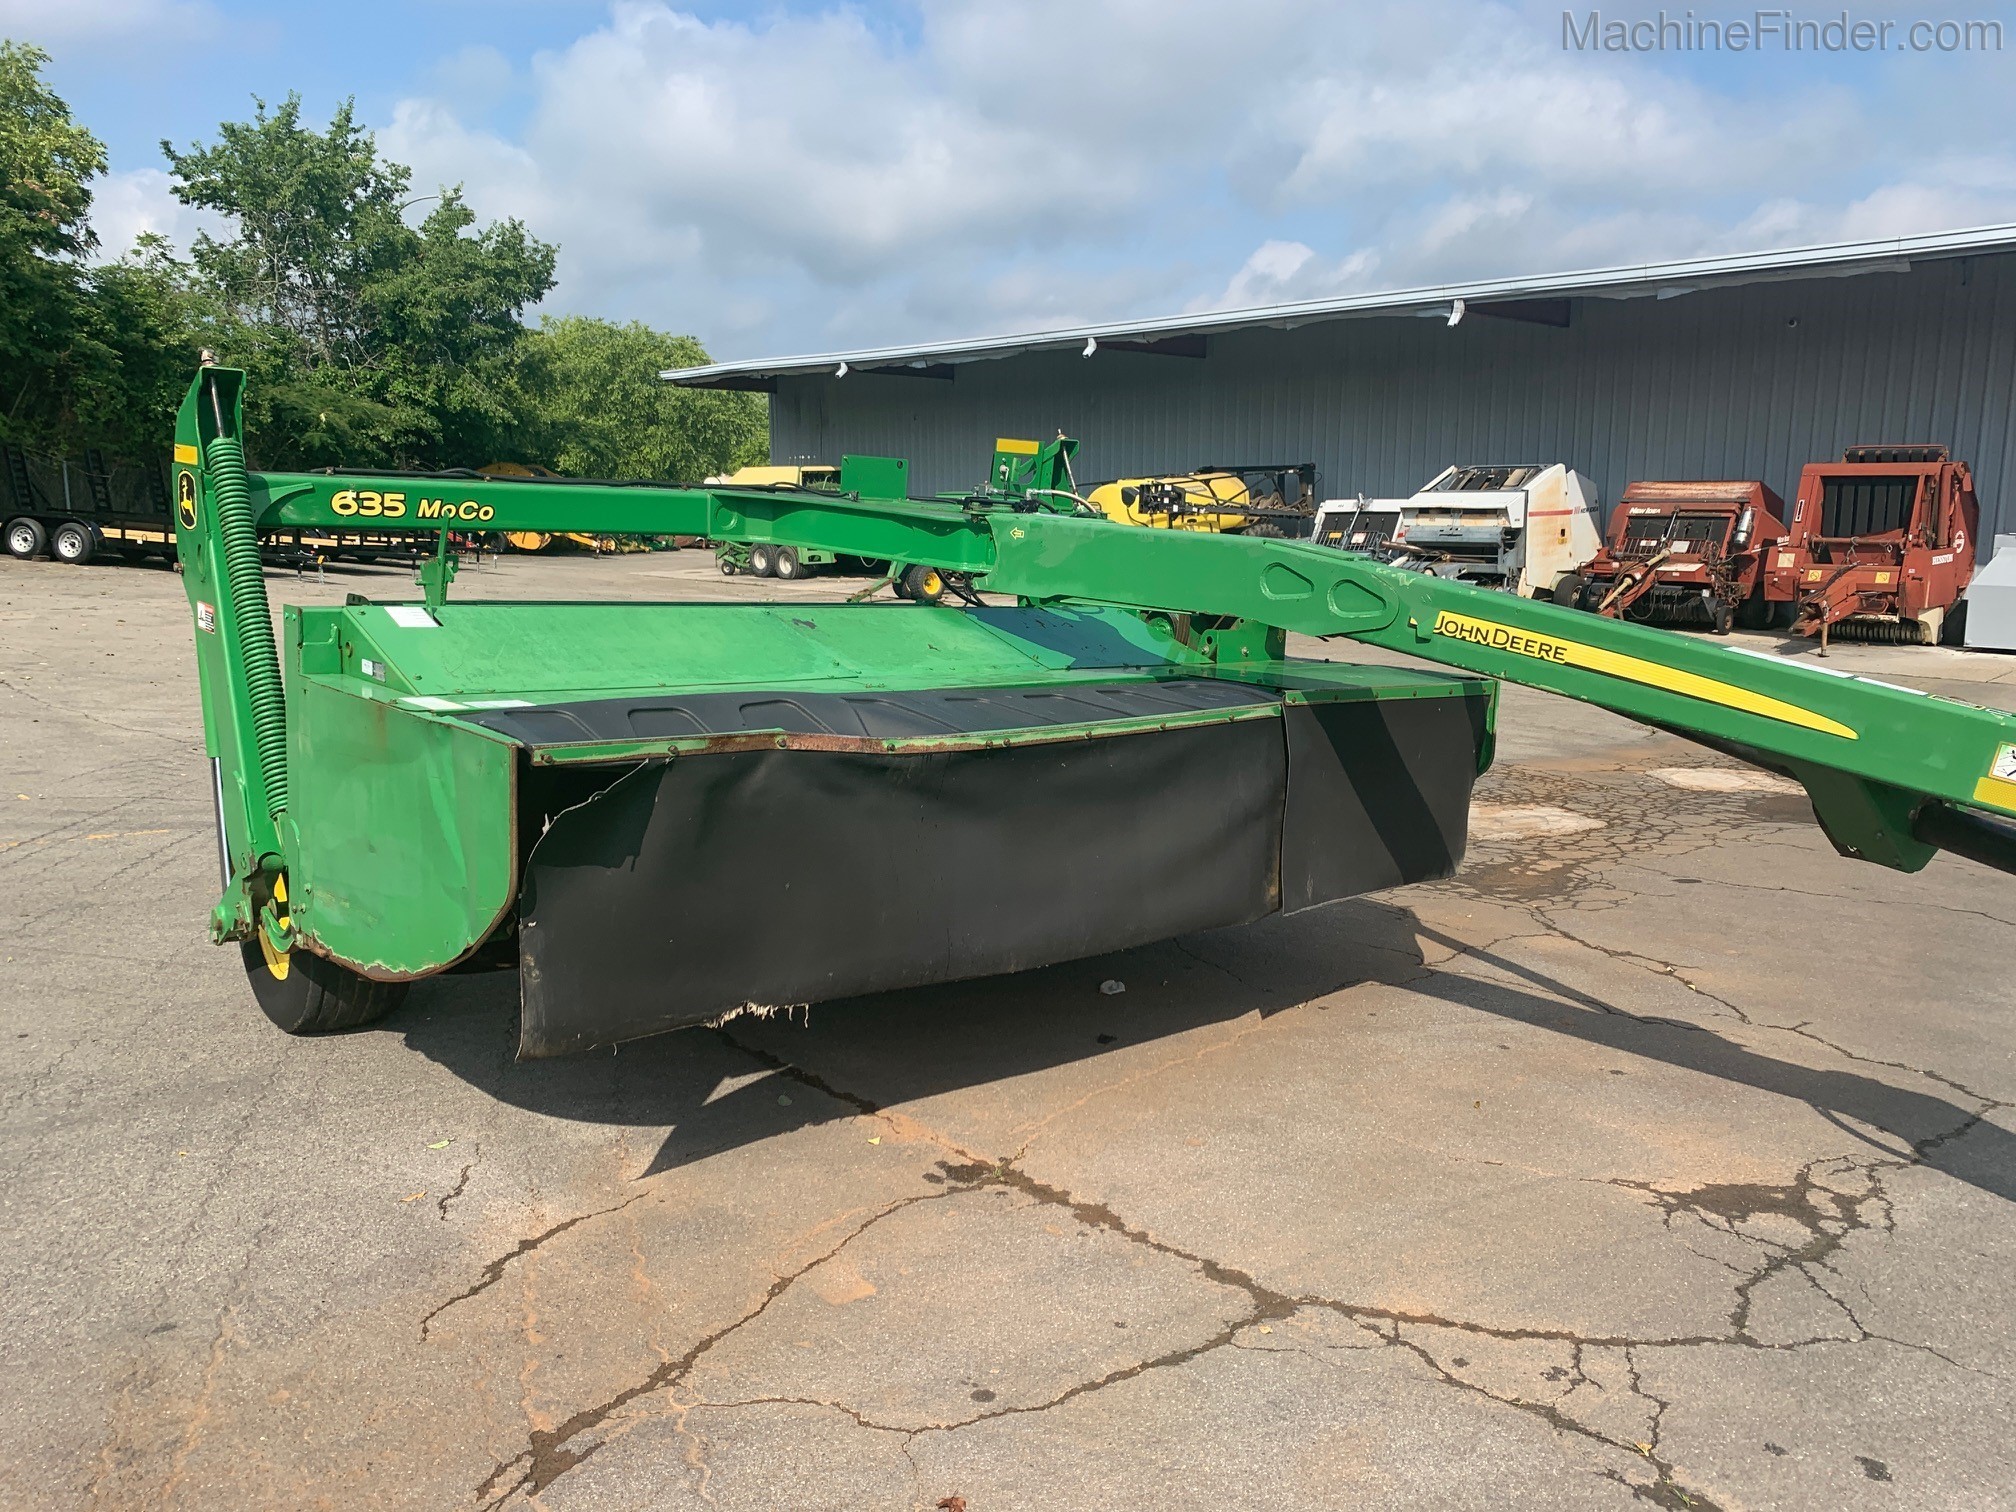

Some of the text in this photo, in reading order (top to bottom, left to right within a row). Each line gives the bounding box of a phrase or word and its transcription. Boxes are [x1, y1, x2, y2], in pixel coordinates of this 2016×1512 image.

[331, 490, 495, 522] 635 MoCo
[1433, 615, 1567, 662] JOHN DEERE
